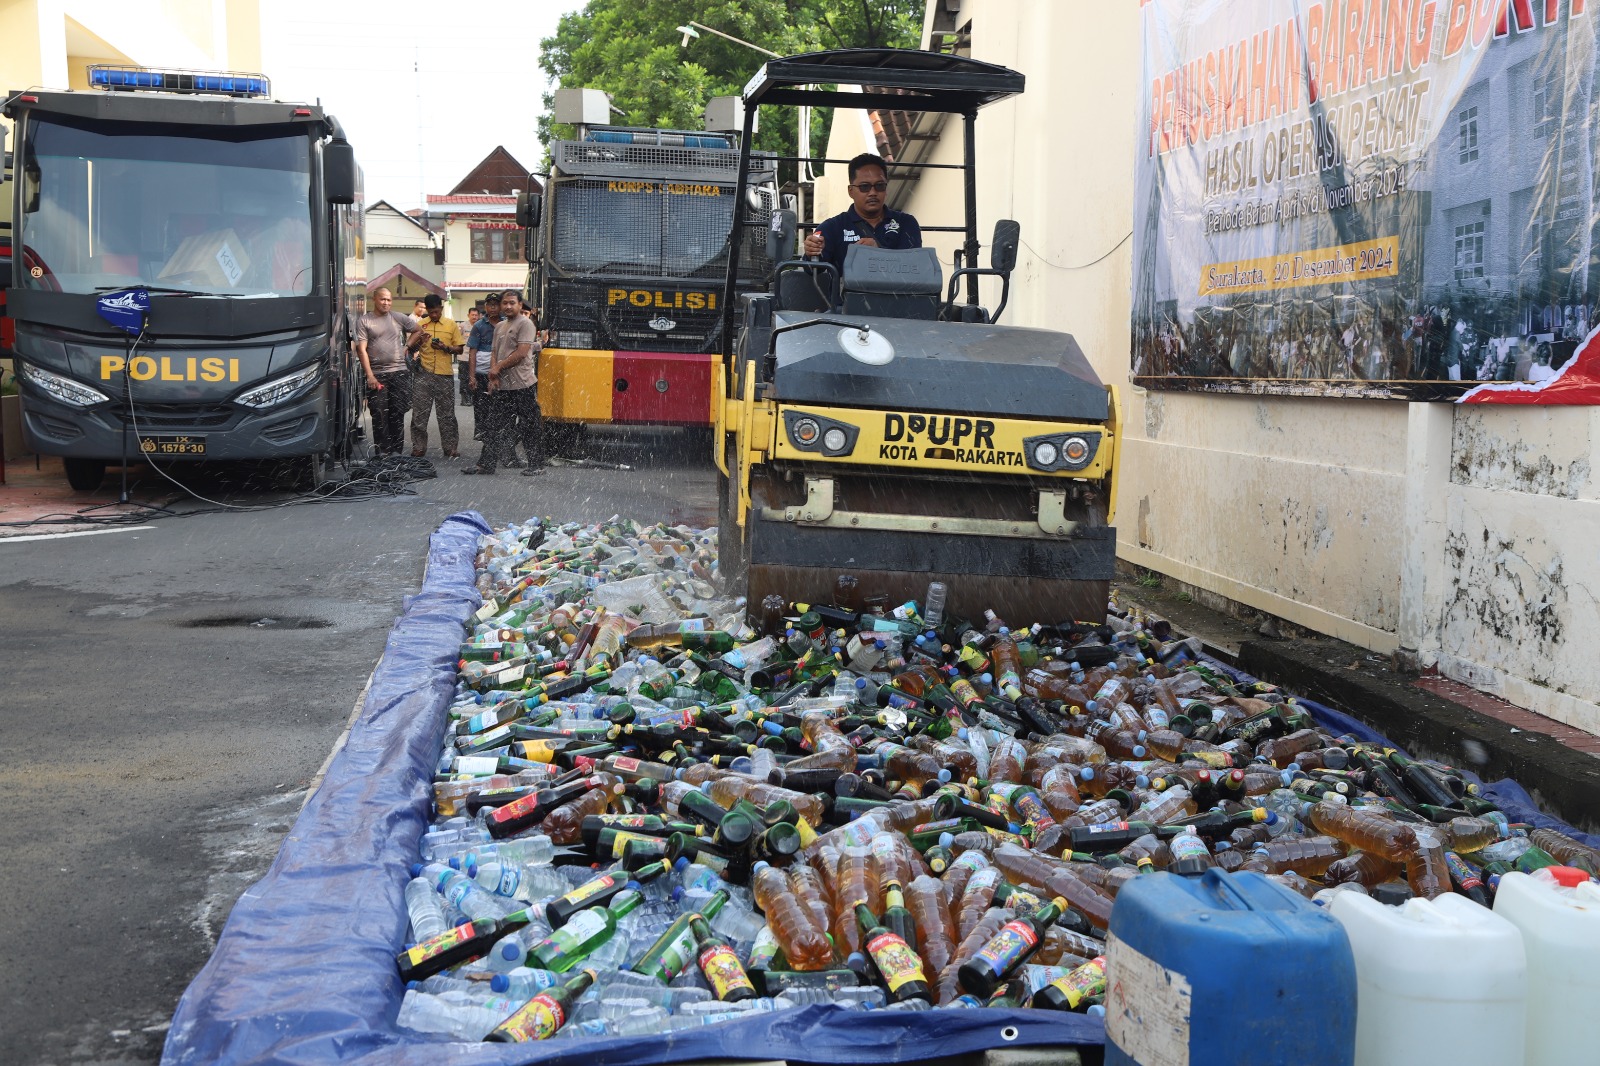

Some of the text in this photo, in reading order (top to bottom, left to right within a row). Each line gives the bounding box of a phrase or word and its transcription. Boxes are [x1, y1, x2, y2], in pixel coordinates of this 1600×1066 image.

[1307, 0, 1436, 105] BARANG
[1204, 77, 1432, 199] HASIL OPERASI PEKAT
[1205, 205, 1245, 235] Periode
[1302, 185, 1321, 216] s/d
[1322, 178, 1376, 213] November
[1375, 163, 1406, 198] 2024
[220, 250, 239, 280] KPU
[1208, 246, 1393, 289] Surakarta, 20 Desember 2024
[607, 288, 717, 310] POLISI
[100, 355, 240, 382] POLISI
[884, 413, 995, 450] DPUPR
[161, 444, 205, 454] 1578-30
[879, 445, 918, 461] KOTA
